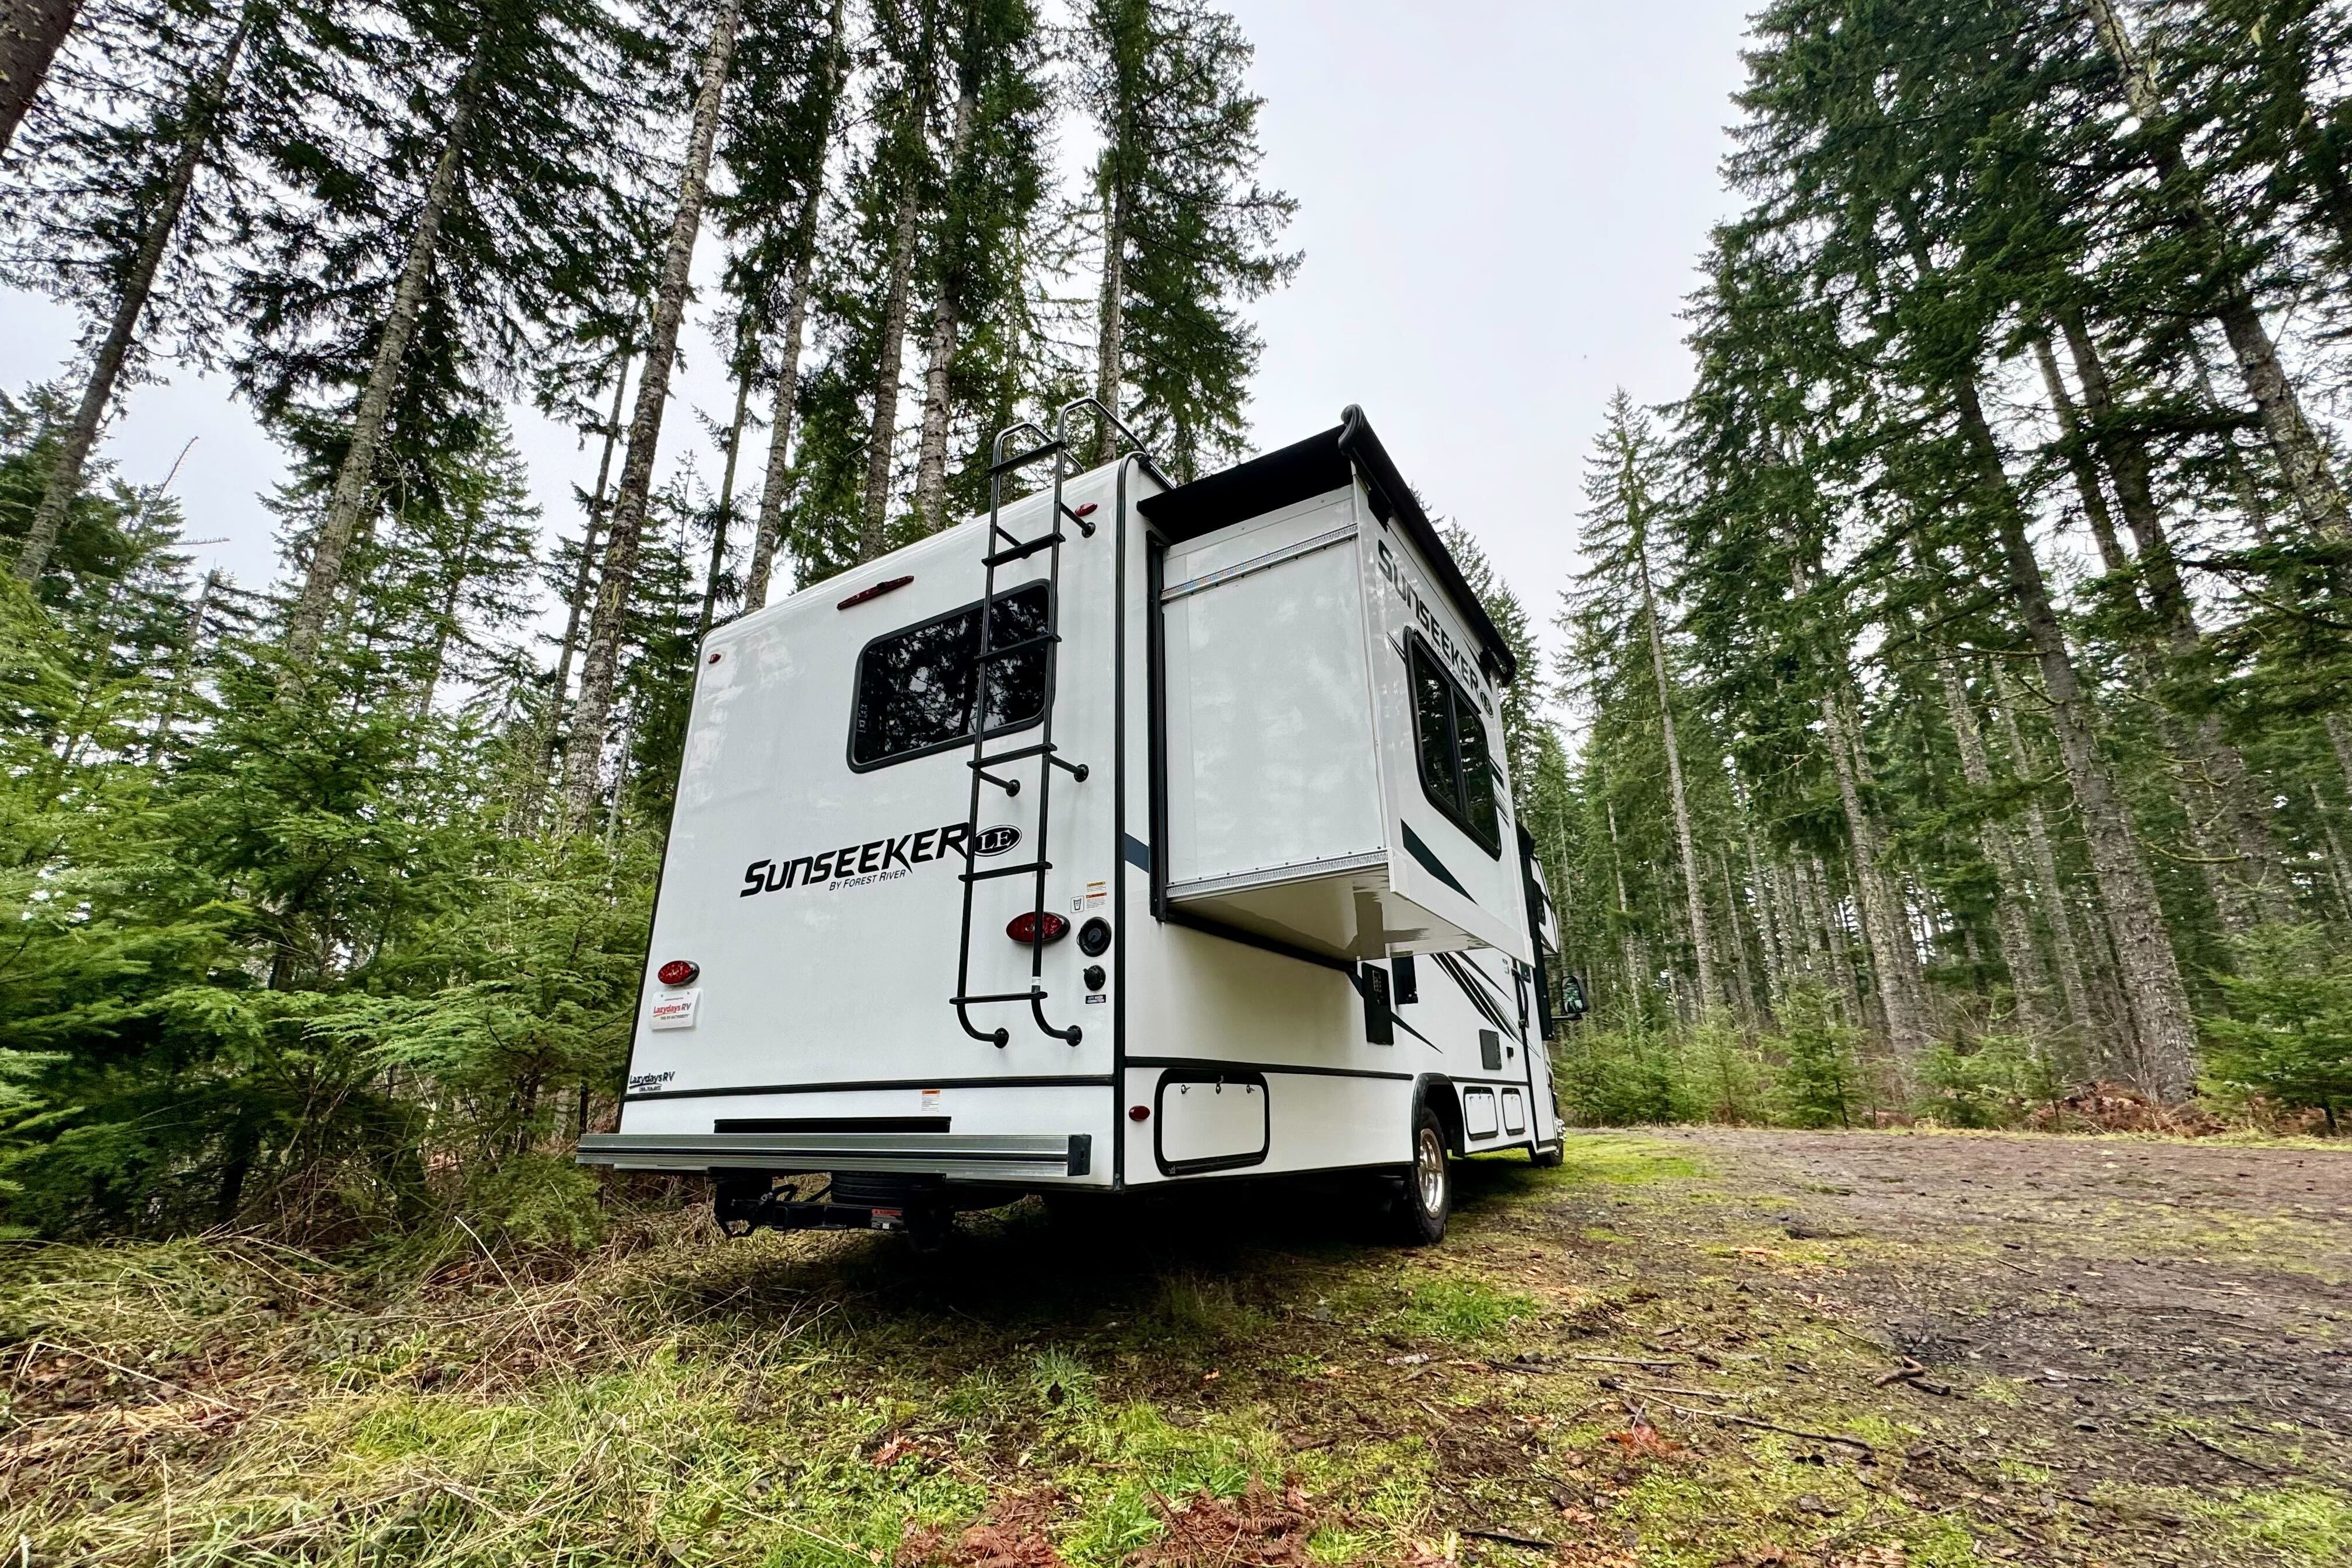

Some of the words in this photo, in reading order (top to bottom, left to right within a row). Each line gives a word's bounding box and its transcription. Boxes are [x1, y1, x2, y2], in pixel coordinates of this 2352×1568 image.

[1378, 538, 1482, 709] SUNSEEKER
[739, 822, 970, 897] SUNSEEKER
[978, 828, 1012, 851] LE
[829, 881, 842, 891] BY
[843, 874, 878, 888] FOREST
[879, 869, 906, 881] RIVER
[653, 1004, 681, 1014] Lazydays
[681, 1002, 692, 1011] RV
[629, 1073, 663, 1084] Lazydays
[663, 1071, 676, 1082] RV
